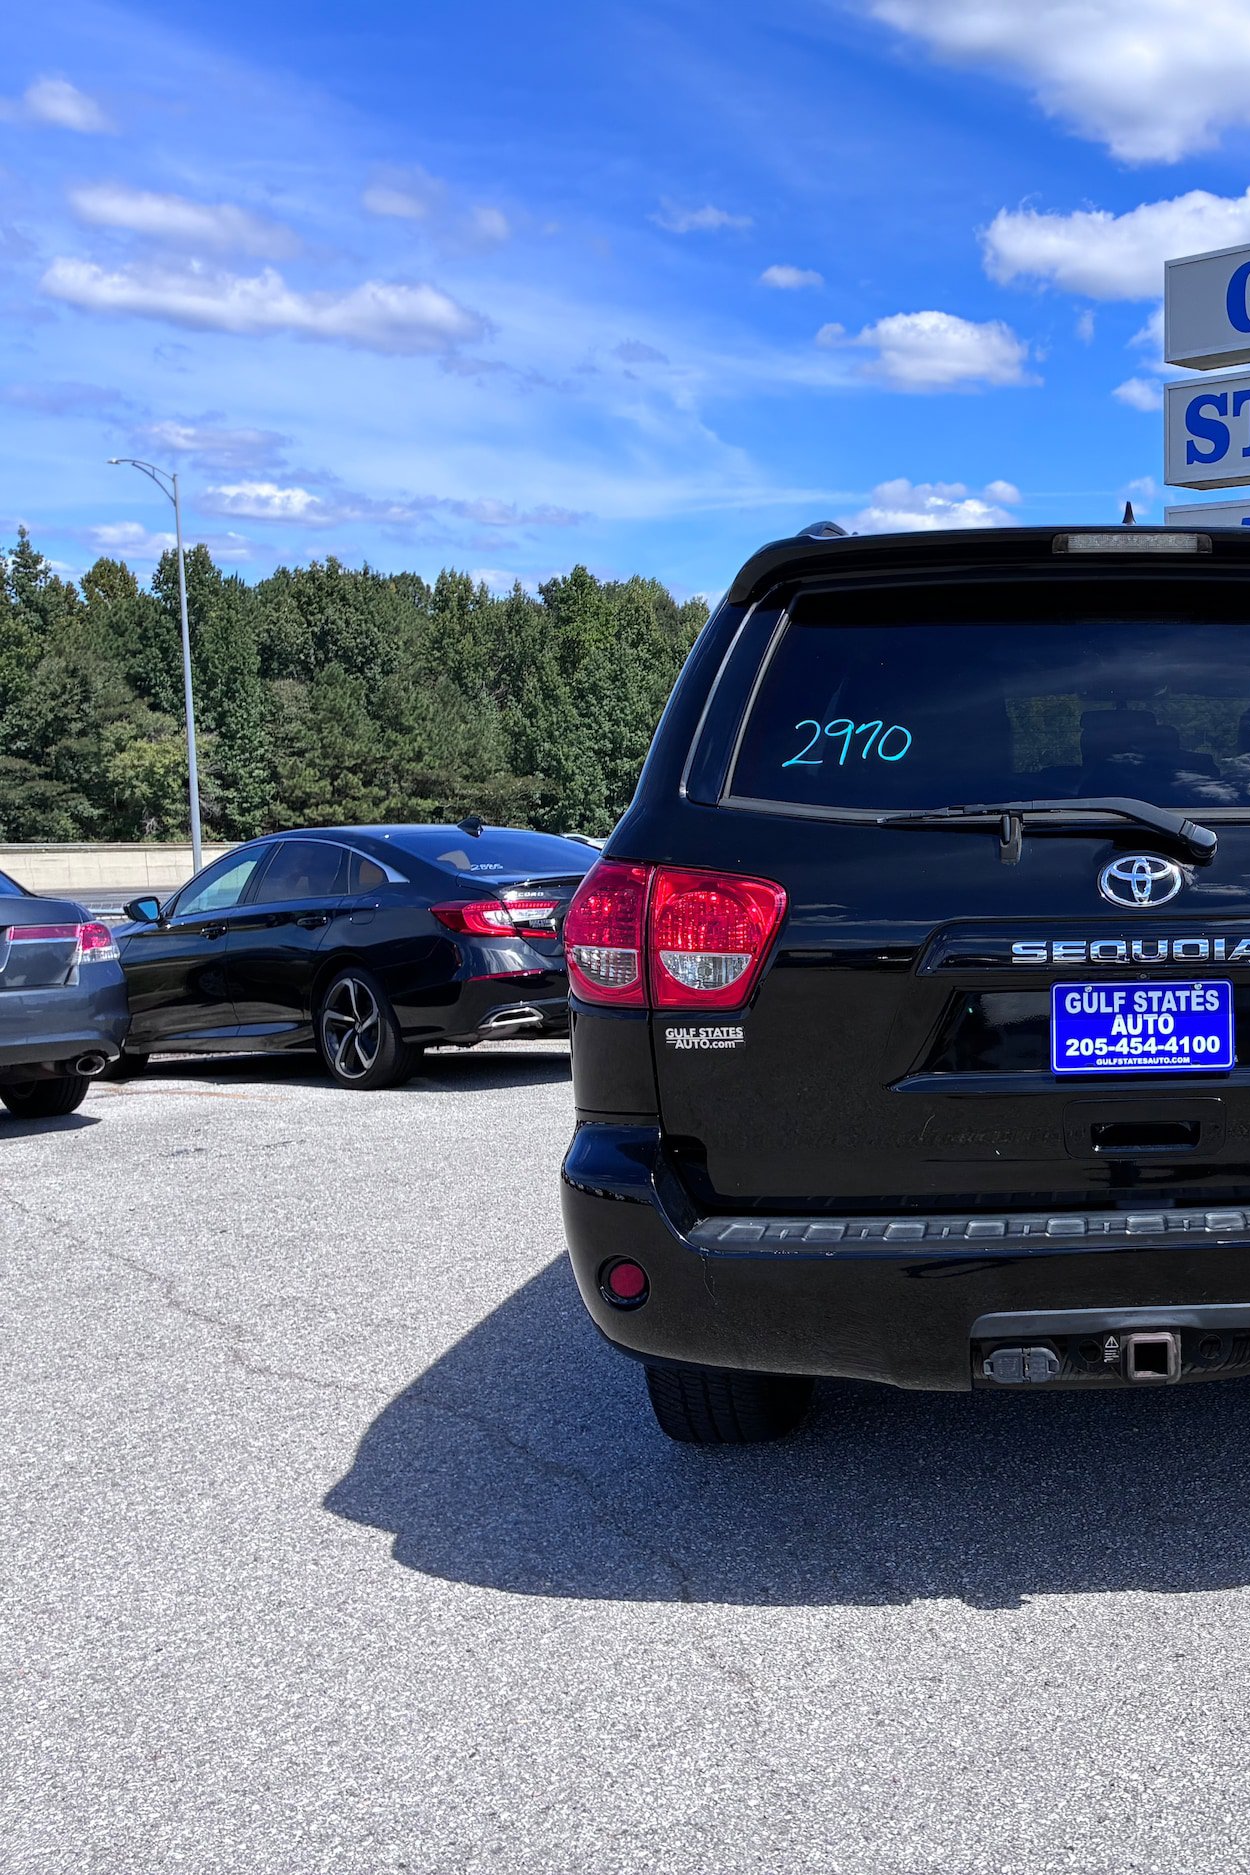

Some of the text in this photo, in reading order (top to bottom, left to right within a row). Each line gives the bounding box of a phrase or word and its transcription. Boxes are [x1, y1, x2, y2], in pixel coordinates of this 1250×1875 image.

[782, 719, 913, 767] 2970
[1065, 989, 1220, 1014] GULF STATES
[665, 1027, 743, 1038] GULF STATES
[1111, 1013, 1174, 1036] AUTO
[675, 1040, 735, 1049] AUTO.com
[1066, 1036, 1220, 1056] 205-454-4100
[1096, 1057, 1190, 1066] GULFSTATESAUTO.COM
